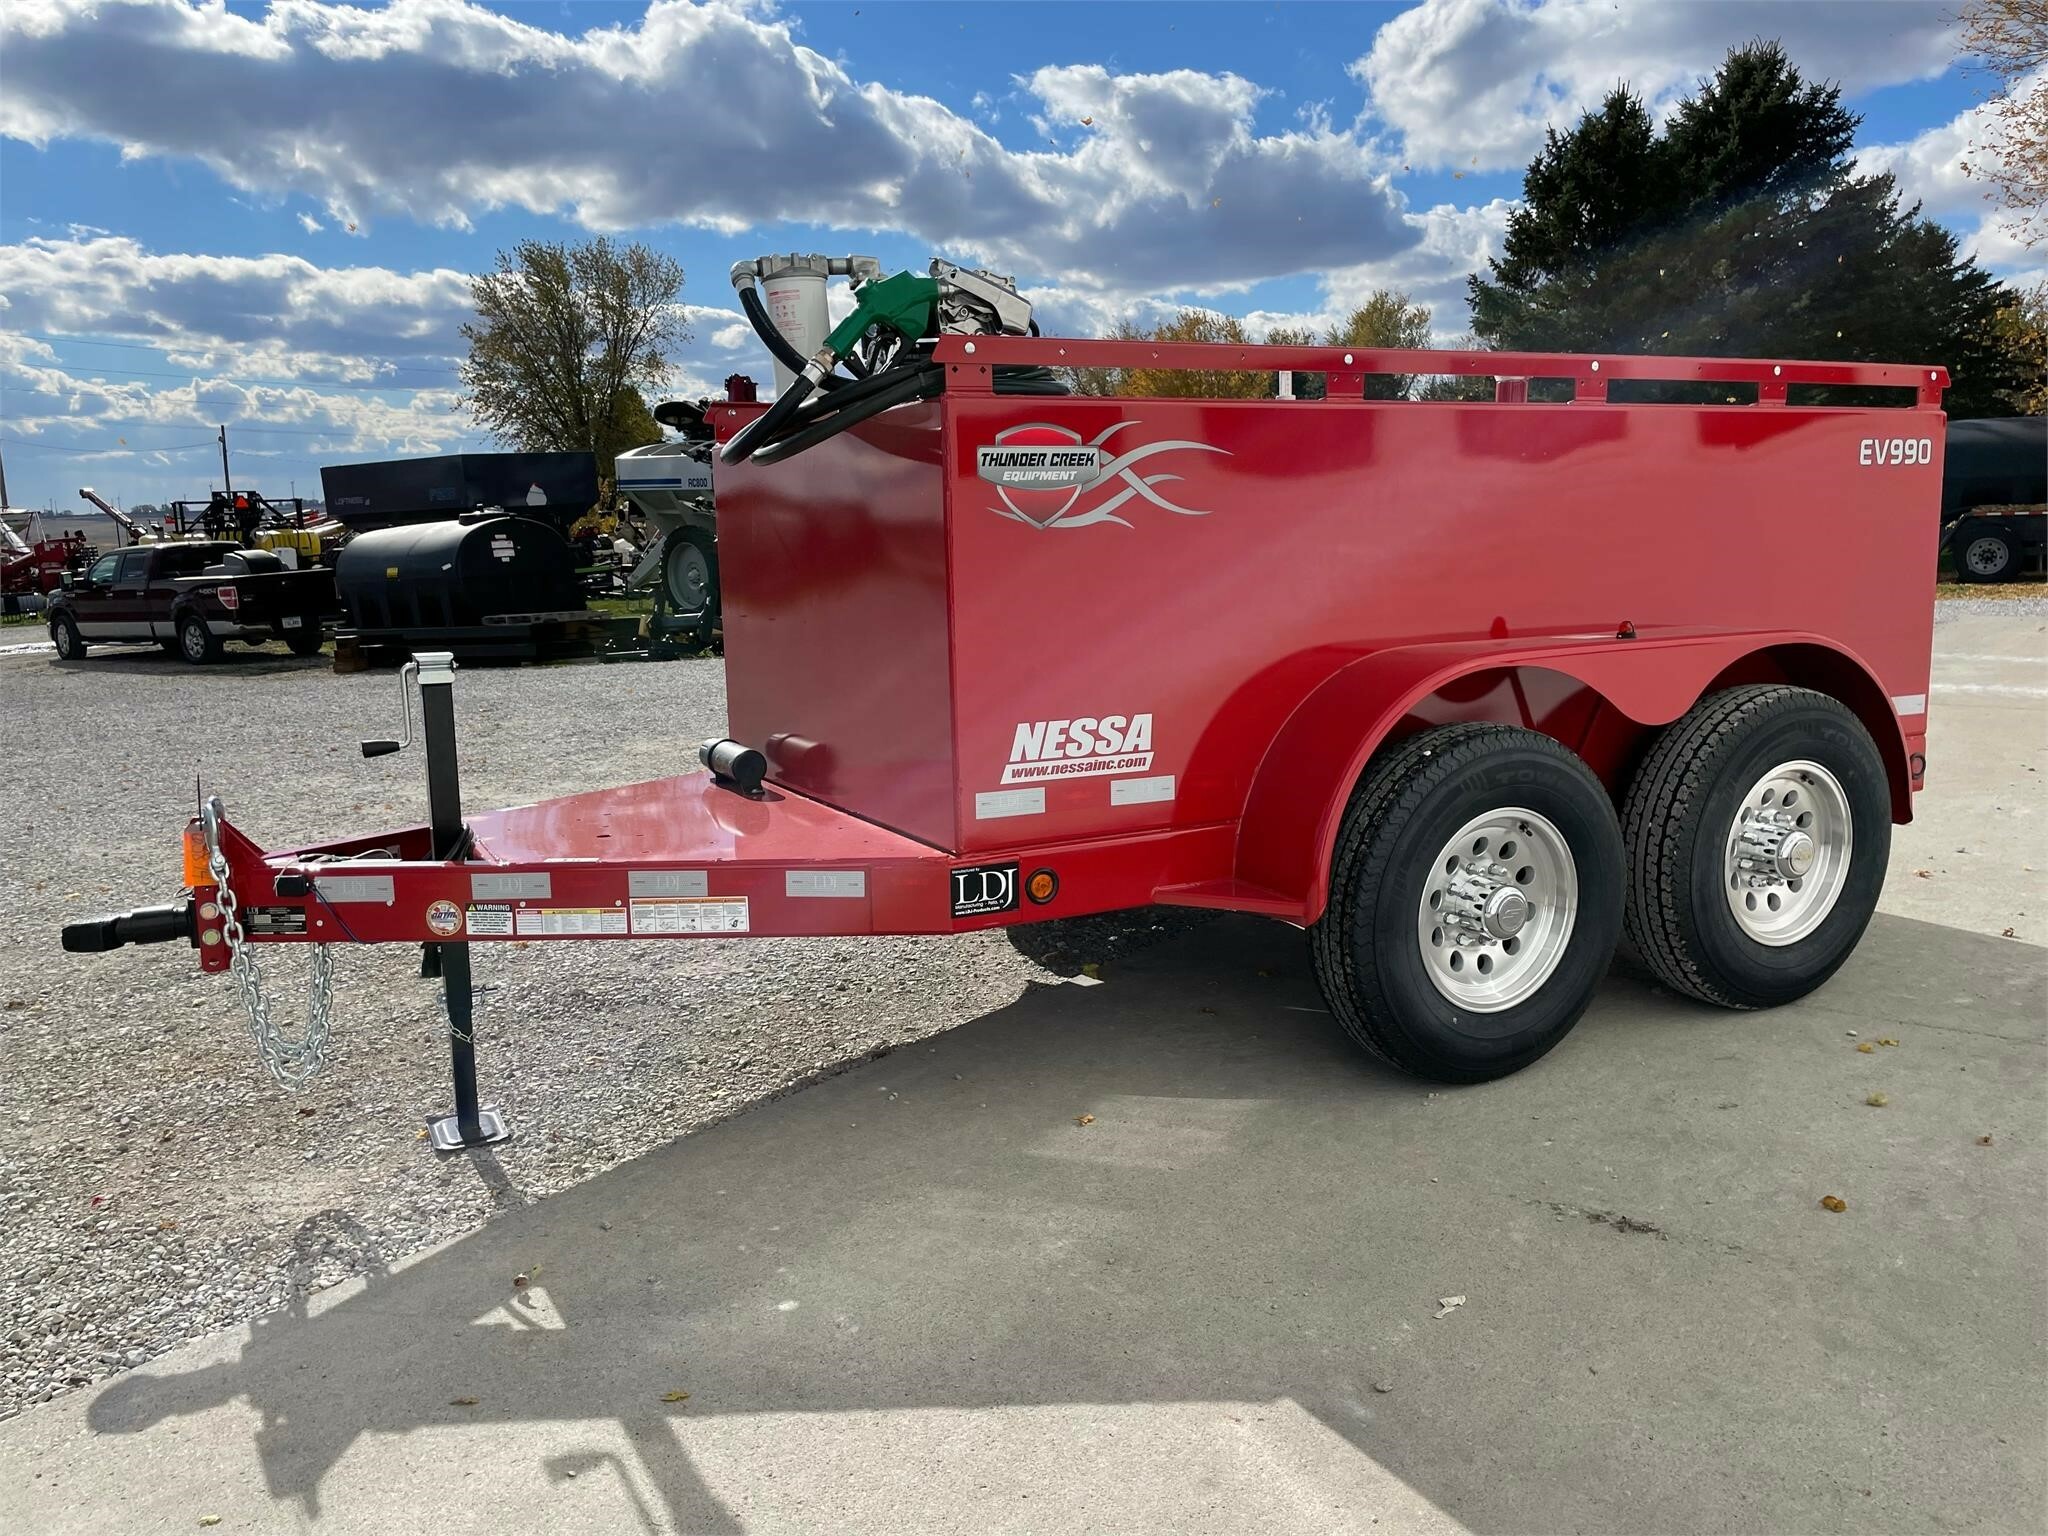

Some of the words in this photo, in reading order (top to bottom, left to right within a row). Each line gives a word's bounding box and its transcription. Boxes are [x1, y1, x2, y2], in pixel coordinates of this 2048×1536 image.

[981, 452, 1045, 467] THUNDER
[1050, 452, 1096, 467] CREEK
[1860, 439, 1932, 465] EV990
[688, 478, 707, 487] RC800
[1002, 471, 1077, 482] EQUIPMENT
[1009, 713, 1153, 762] NESSA
[1011, 756, 1147, 779] www.nessainc.com
[955, 868, 1017, 908] LDJ
